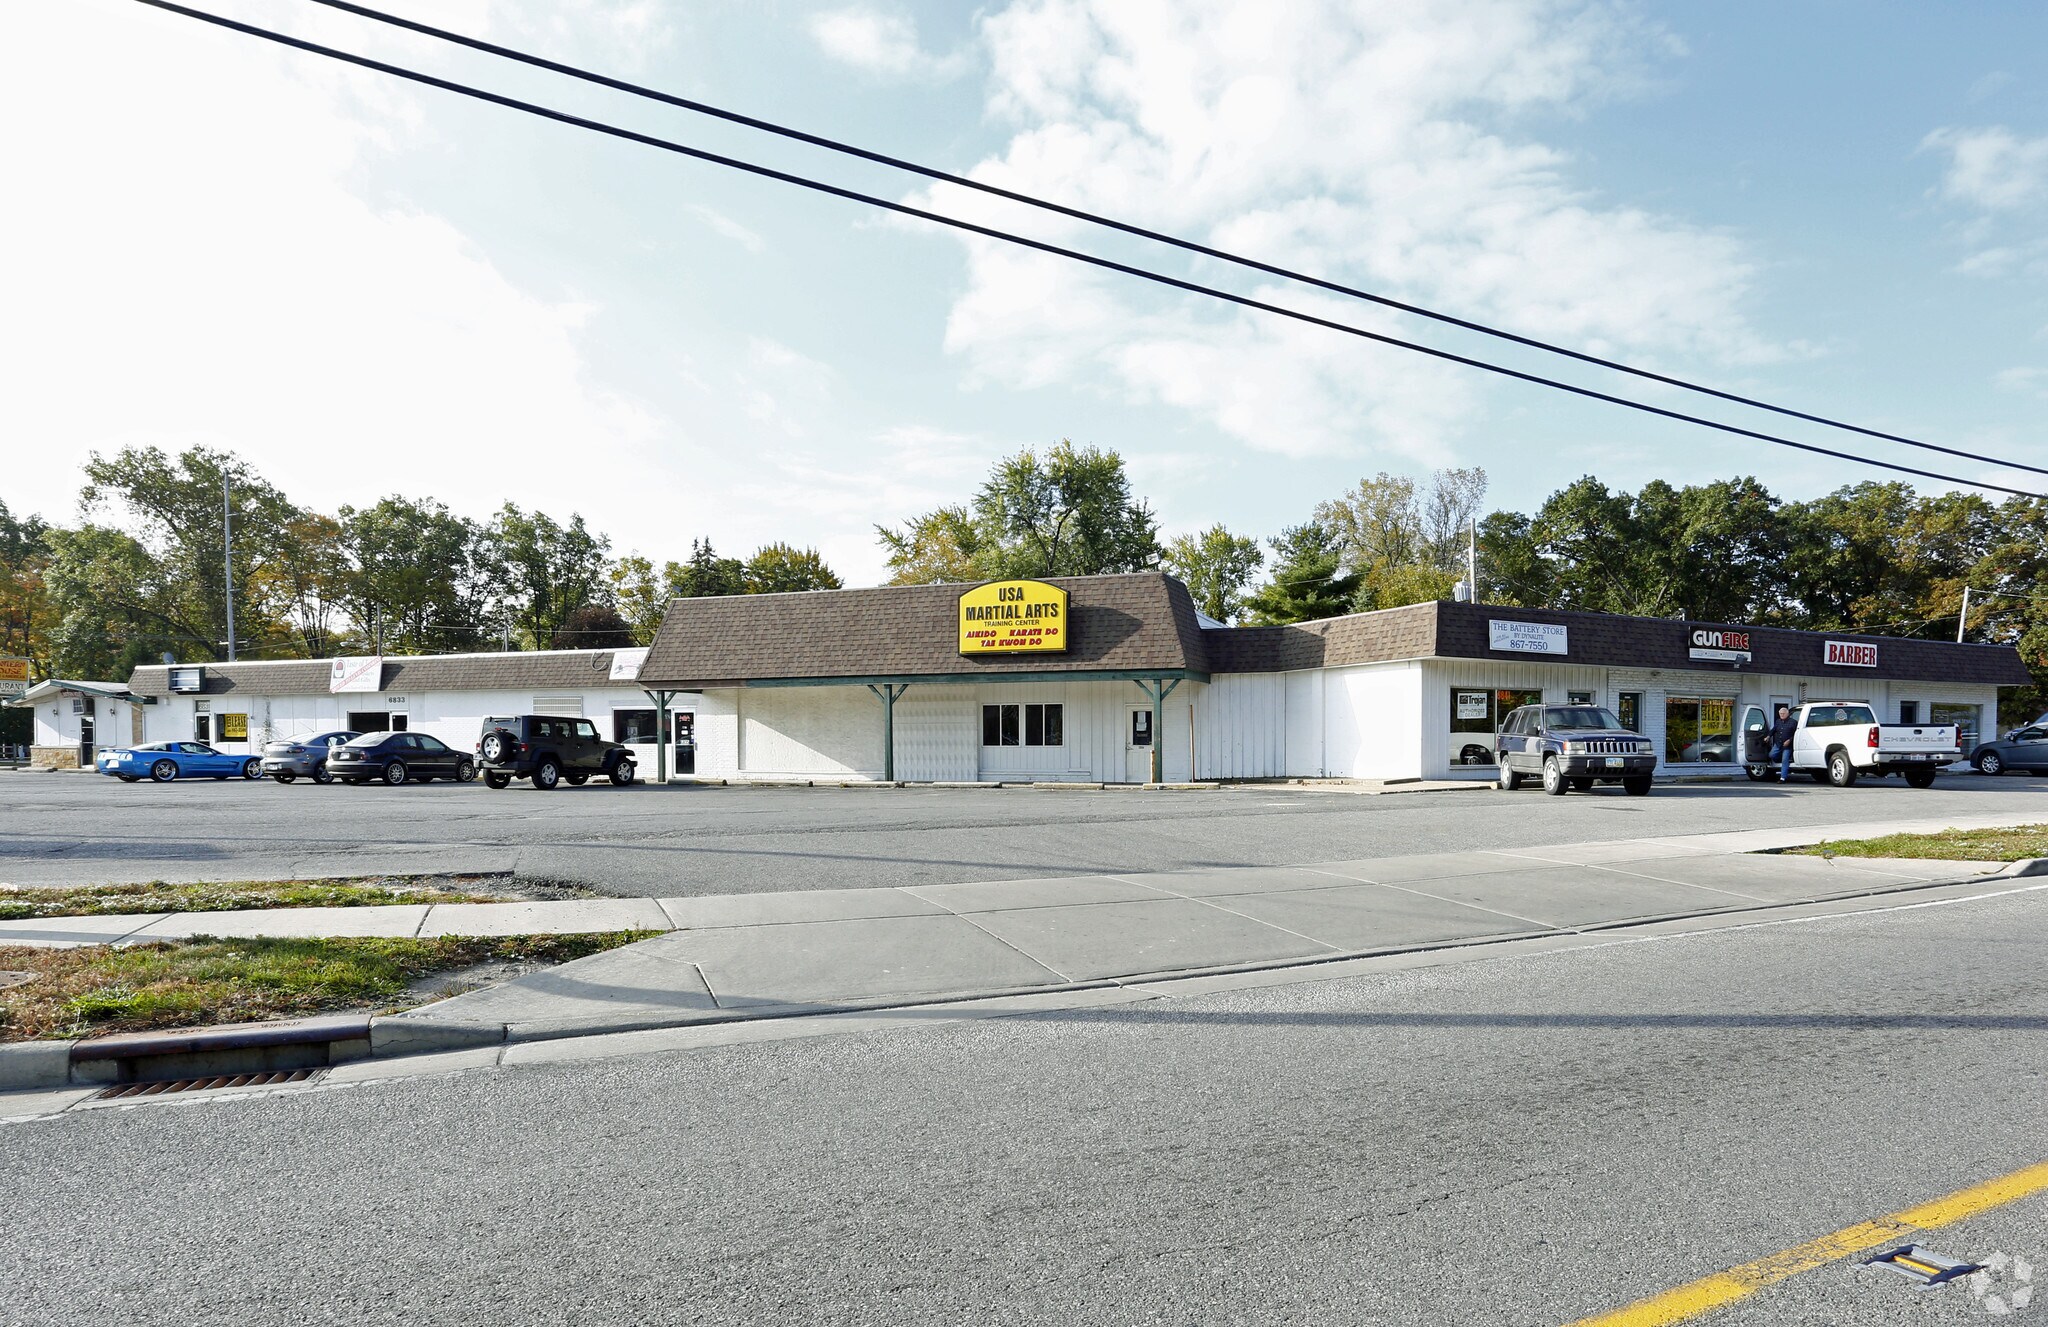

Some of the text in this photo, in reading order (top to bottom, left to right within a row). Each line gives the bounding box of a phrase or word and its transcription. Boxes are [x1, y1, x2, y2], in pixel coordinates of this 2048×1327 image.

[998, 587, 1024, 602] USA
[966, 602, 1059, 620] MARTIAL ARTS
[966, 628, 1058, 638] AIKIDO KARATE DO
[1492, 622, 1564, 636] THE BATTERY STORE
[998, 638, 1026, 646] KWON
[1510, 640, 1548, 650] 867-7550
[1692, 630, 1750, 650] GUNFIRE
[1828, 644, 1876, 666] BARBER
[1468, 695, 1486, 706] Trojan
[232, 716, 246, 727] LEASE
